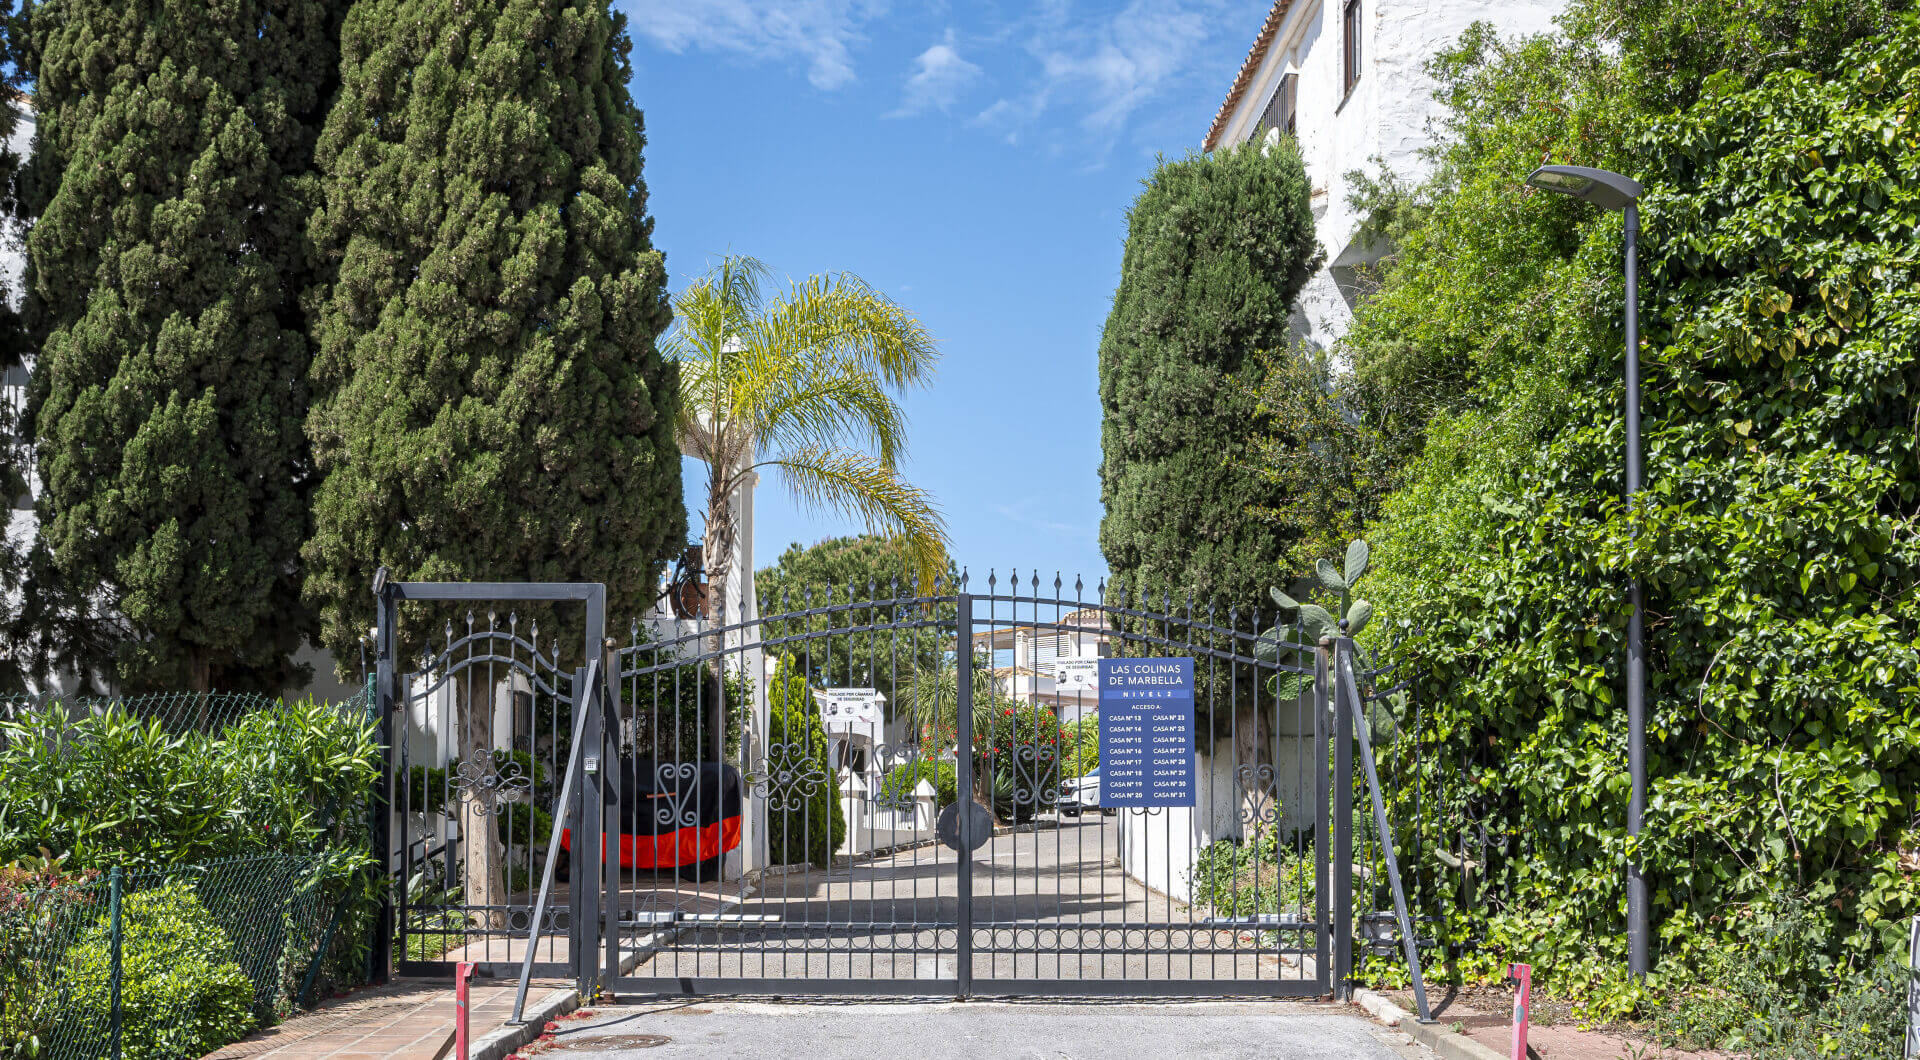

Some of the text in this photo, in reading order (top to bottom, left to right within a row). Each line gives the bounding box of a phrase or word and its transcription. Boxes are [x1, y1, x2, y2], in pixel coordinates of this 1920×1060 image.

[1111, 664, 1181, 674] LAS COLINAS
[1109, 676, 1183, 685] DE MARBELLA
